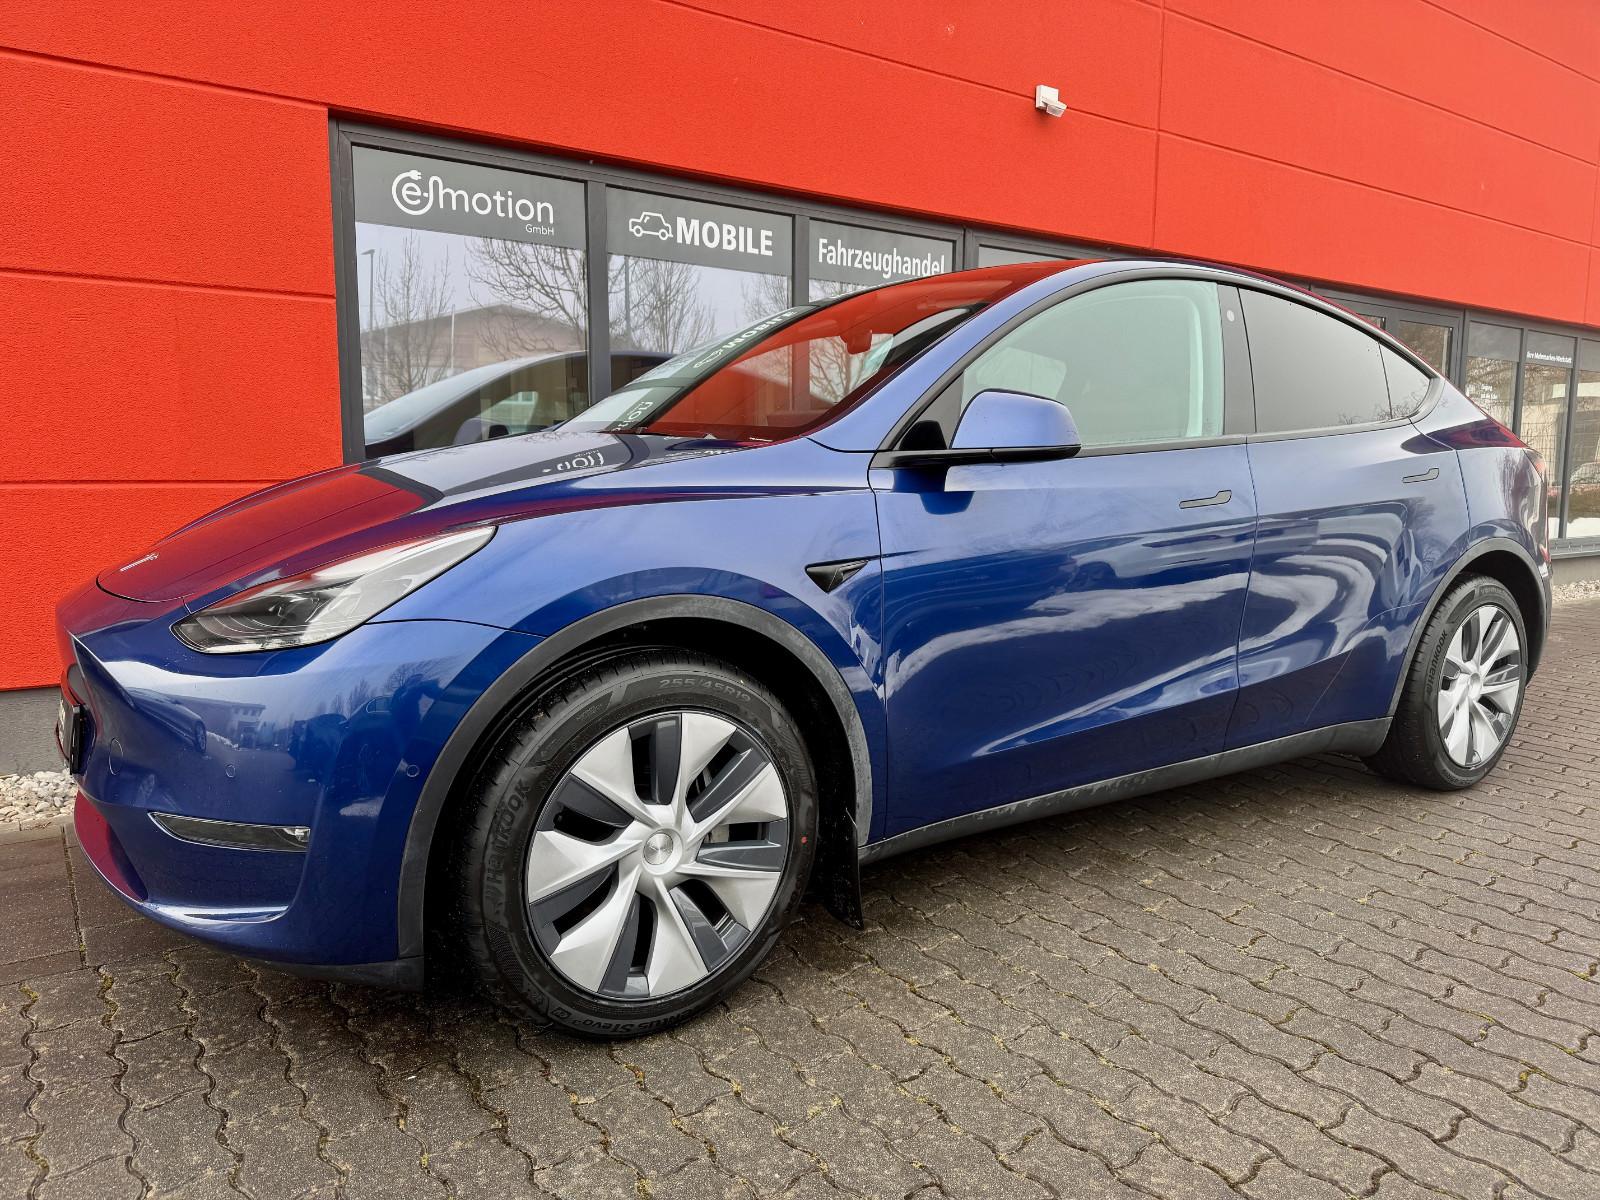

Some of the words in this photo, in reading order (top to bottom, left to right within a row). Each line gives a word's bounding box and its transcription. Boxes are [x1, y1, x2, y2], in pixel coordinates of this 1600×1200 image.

[525, 224, 555, 236] GmbH
[676, 216, 774, 257] MOBILE
[818, 238, 946, 279] Fahrzeughandel
